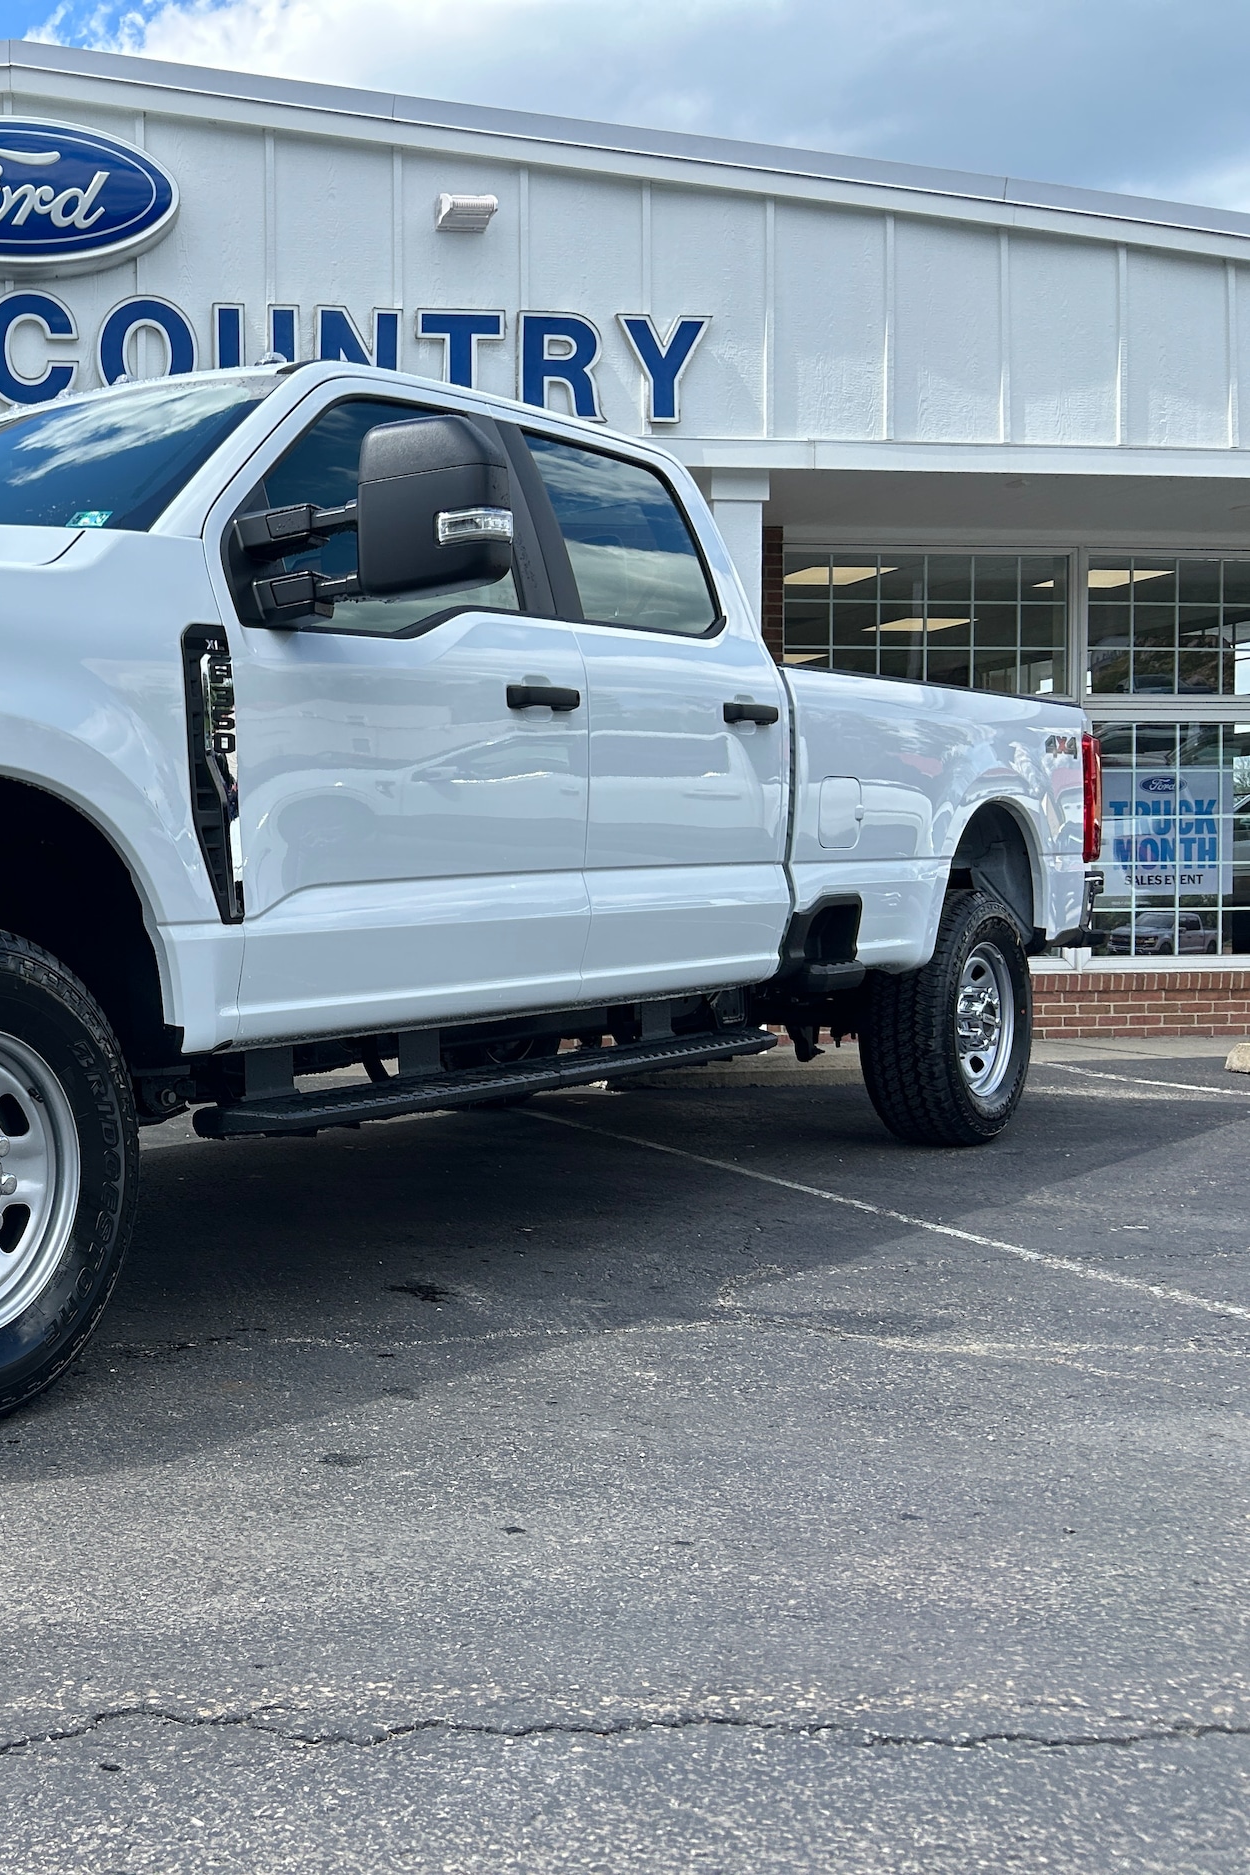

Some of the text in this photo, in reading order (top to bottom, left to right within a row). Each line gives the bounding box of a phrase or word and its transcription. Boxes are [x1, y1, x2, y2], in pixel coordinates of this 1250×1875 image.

[1148, 778, 1180, 791] Ford
[1109, 800, 1217, 836] TRUCK
[1113, 837, 1217, 871] MONTH
[1124, 874, 1203, 886] SALES EVENT
